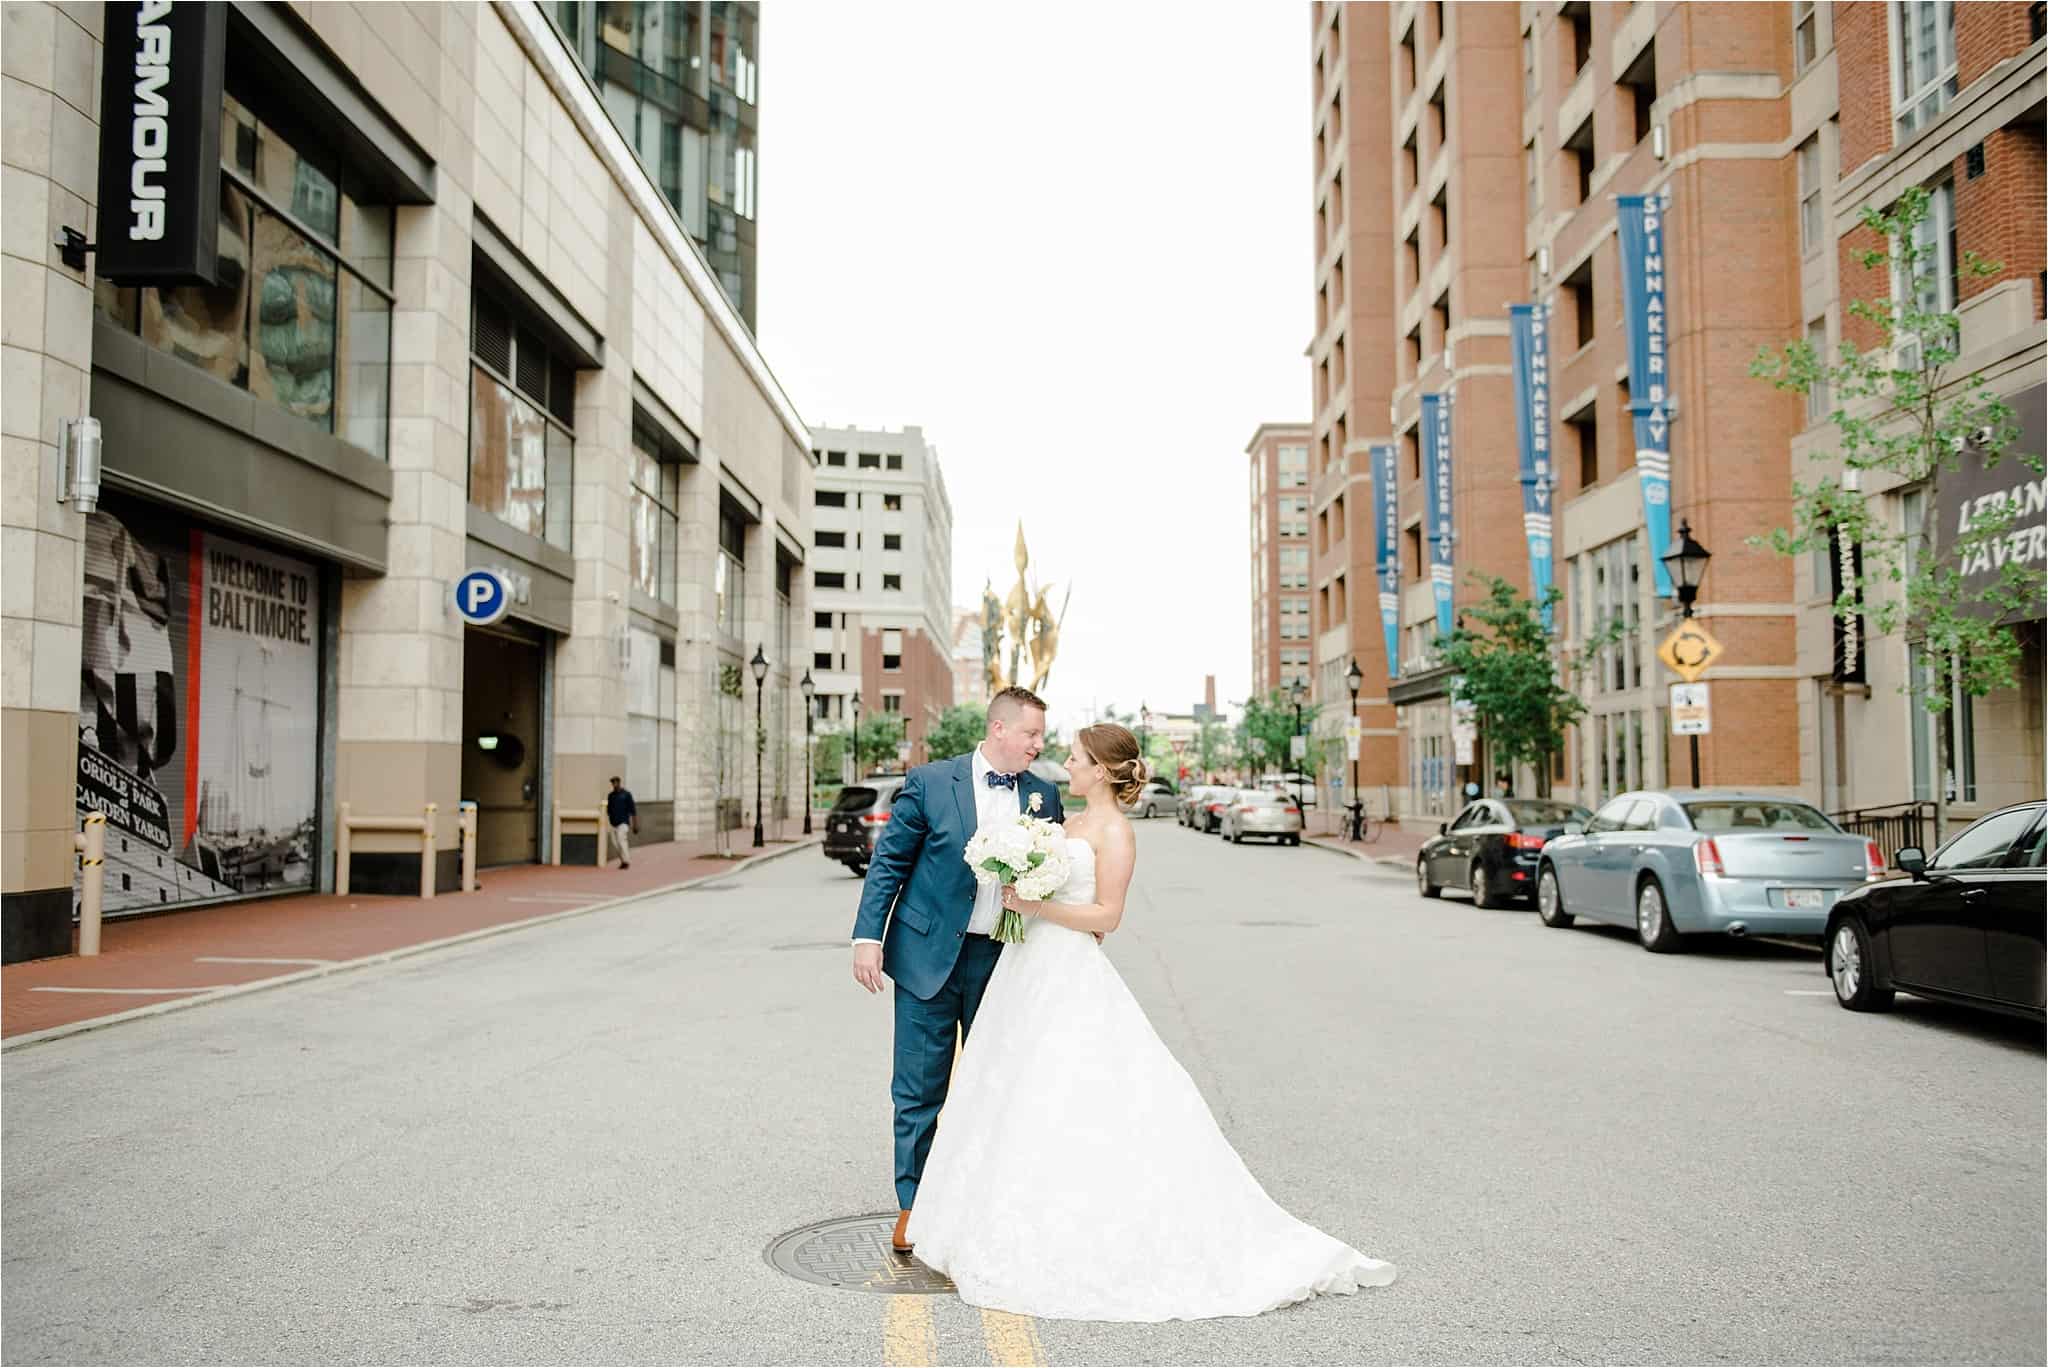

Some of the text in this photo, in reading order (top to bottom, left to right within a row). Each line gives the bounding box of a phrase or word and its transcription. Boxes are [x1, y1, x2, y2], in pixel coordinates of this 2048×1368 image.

[129, 1, 173, 240] ARMOUR
[1643, 196, 1665, 443] SPINNAKER BAY
[1531, 305, 1547, 507] SPINNAKER BAY
[1438, 394, 1450, 514] SPINNAKER
[209, 550, 308, 606] WELCOME TO
[468, 579, 495, 613] P
[209, 586, 311, 647] BALTIMORE.
[76, 783, 170, 848] CAMDEN YARDS
[80, 757, 162, 817] ORIOLE PARK
